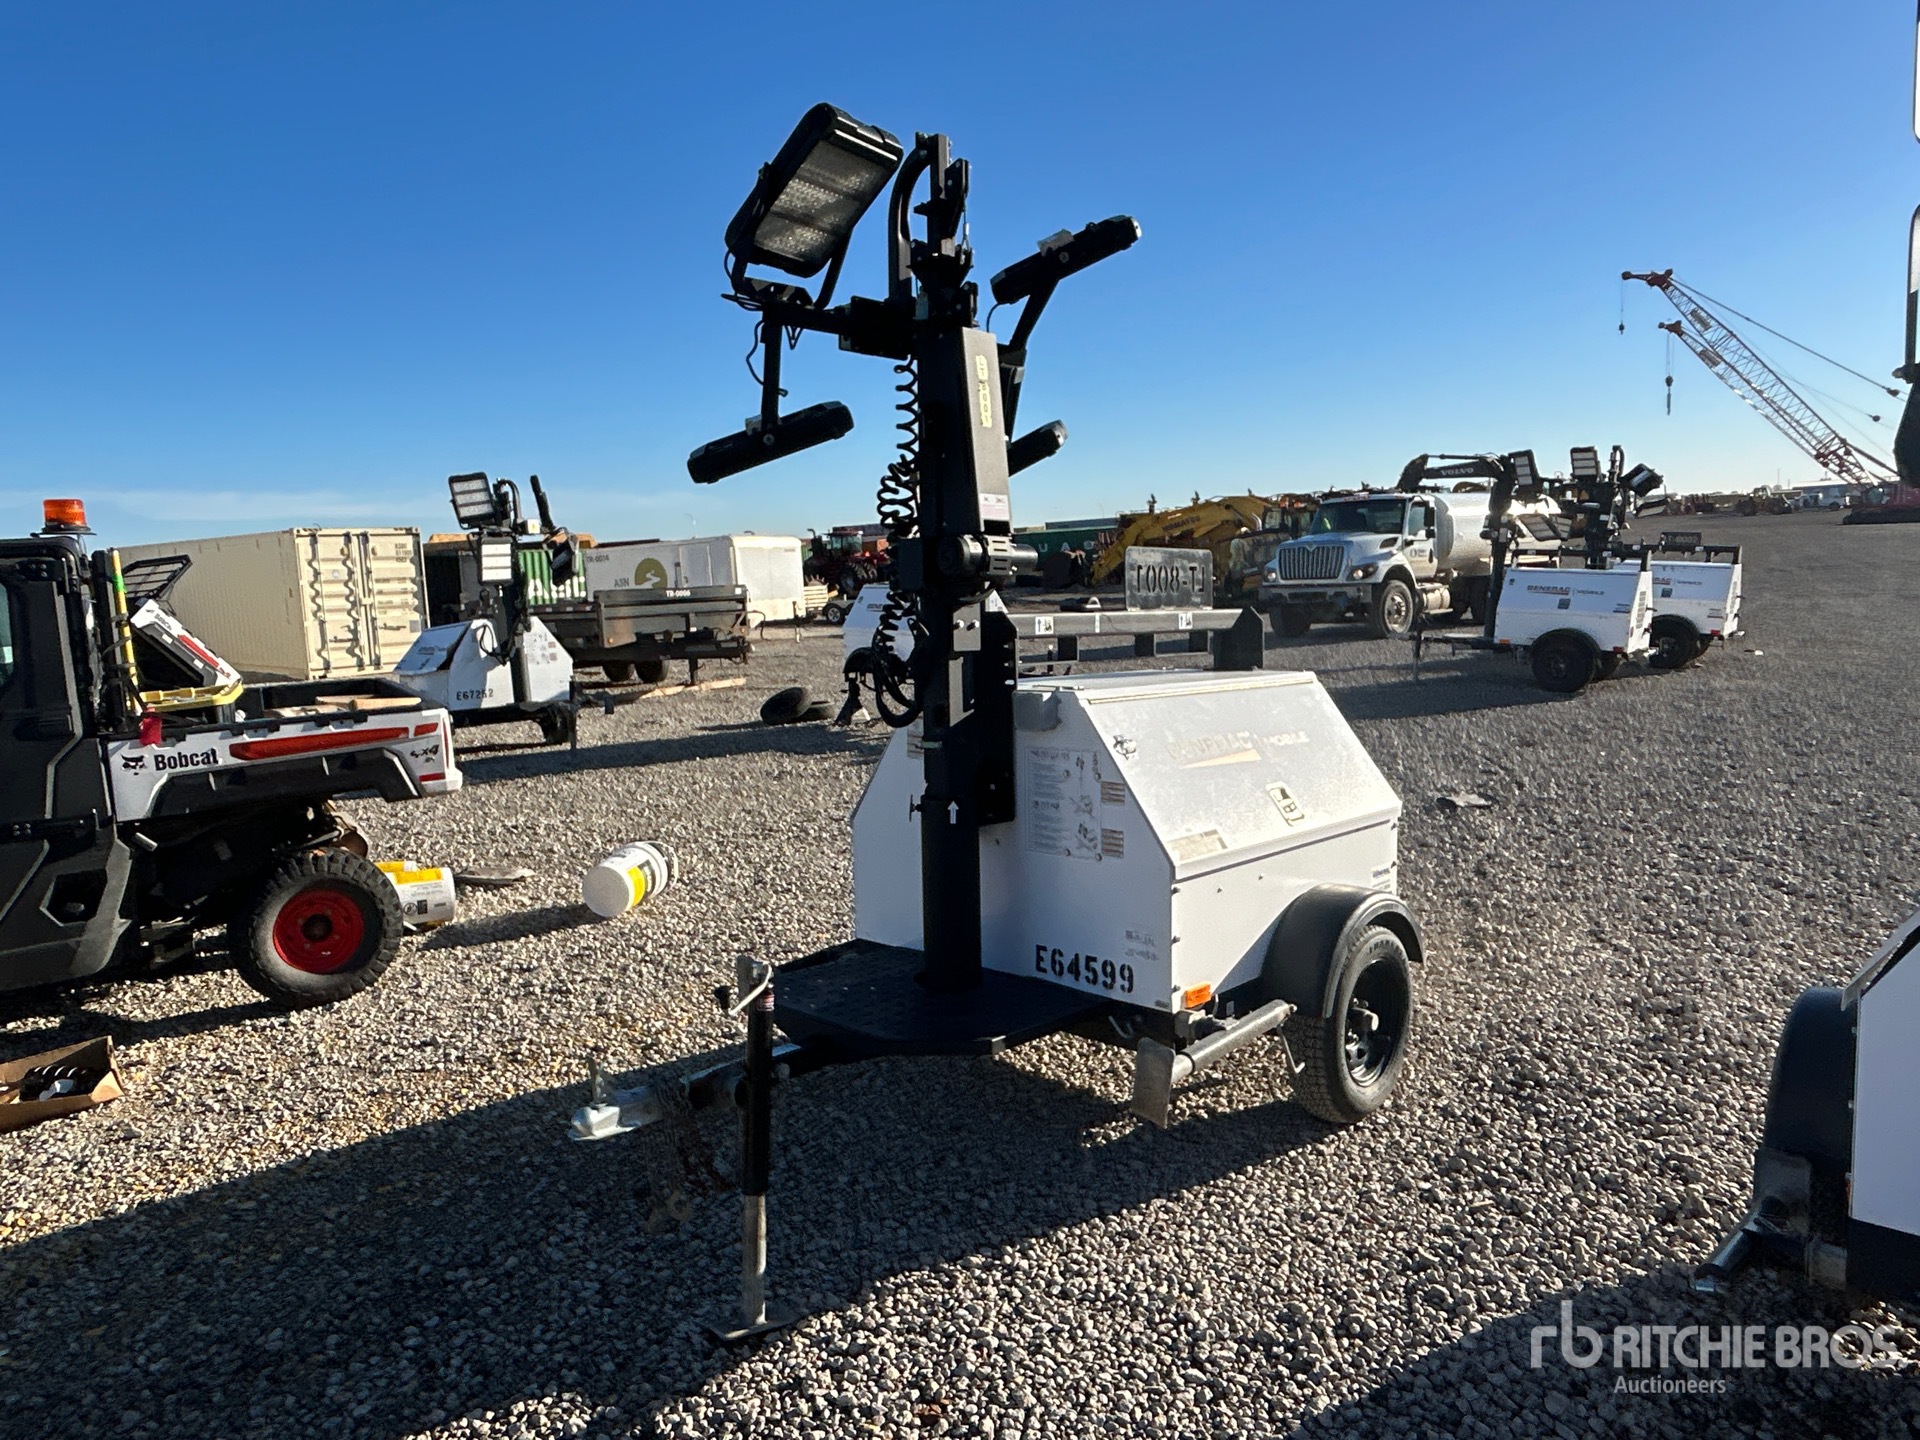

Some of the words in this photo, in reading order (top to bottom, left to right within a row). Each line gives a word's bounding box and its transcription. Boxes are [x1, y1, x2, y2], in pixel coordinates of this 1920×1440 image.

[1440, 467, 1474, 476] VOLVO
[1527, 584, 1570, 593] GENERAC
[153, 747, 219, 771] Bobcat
[1035, 944, 1134, 994] E64599
